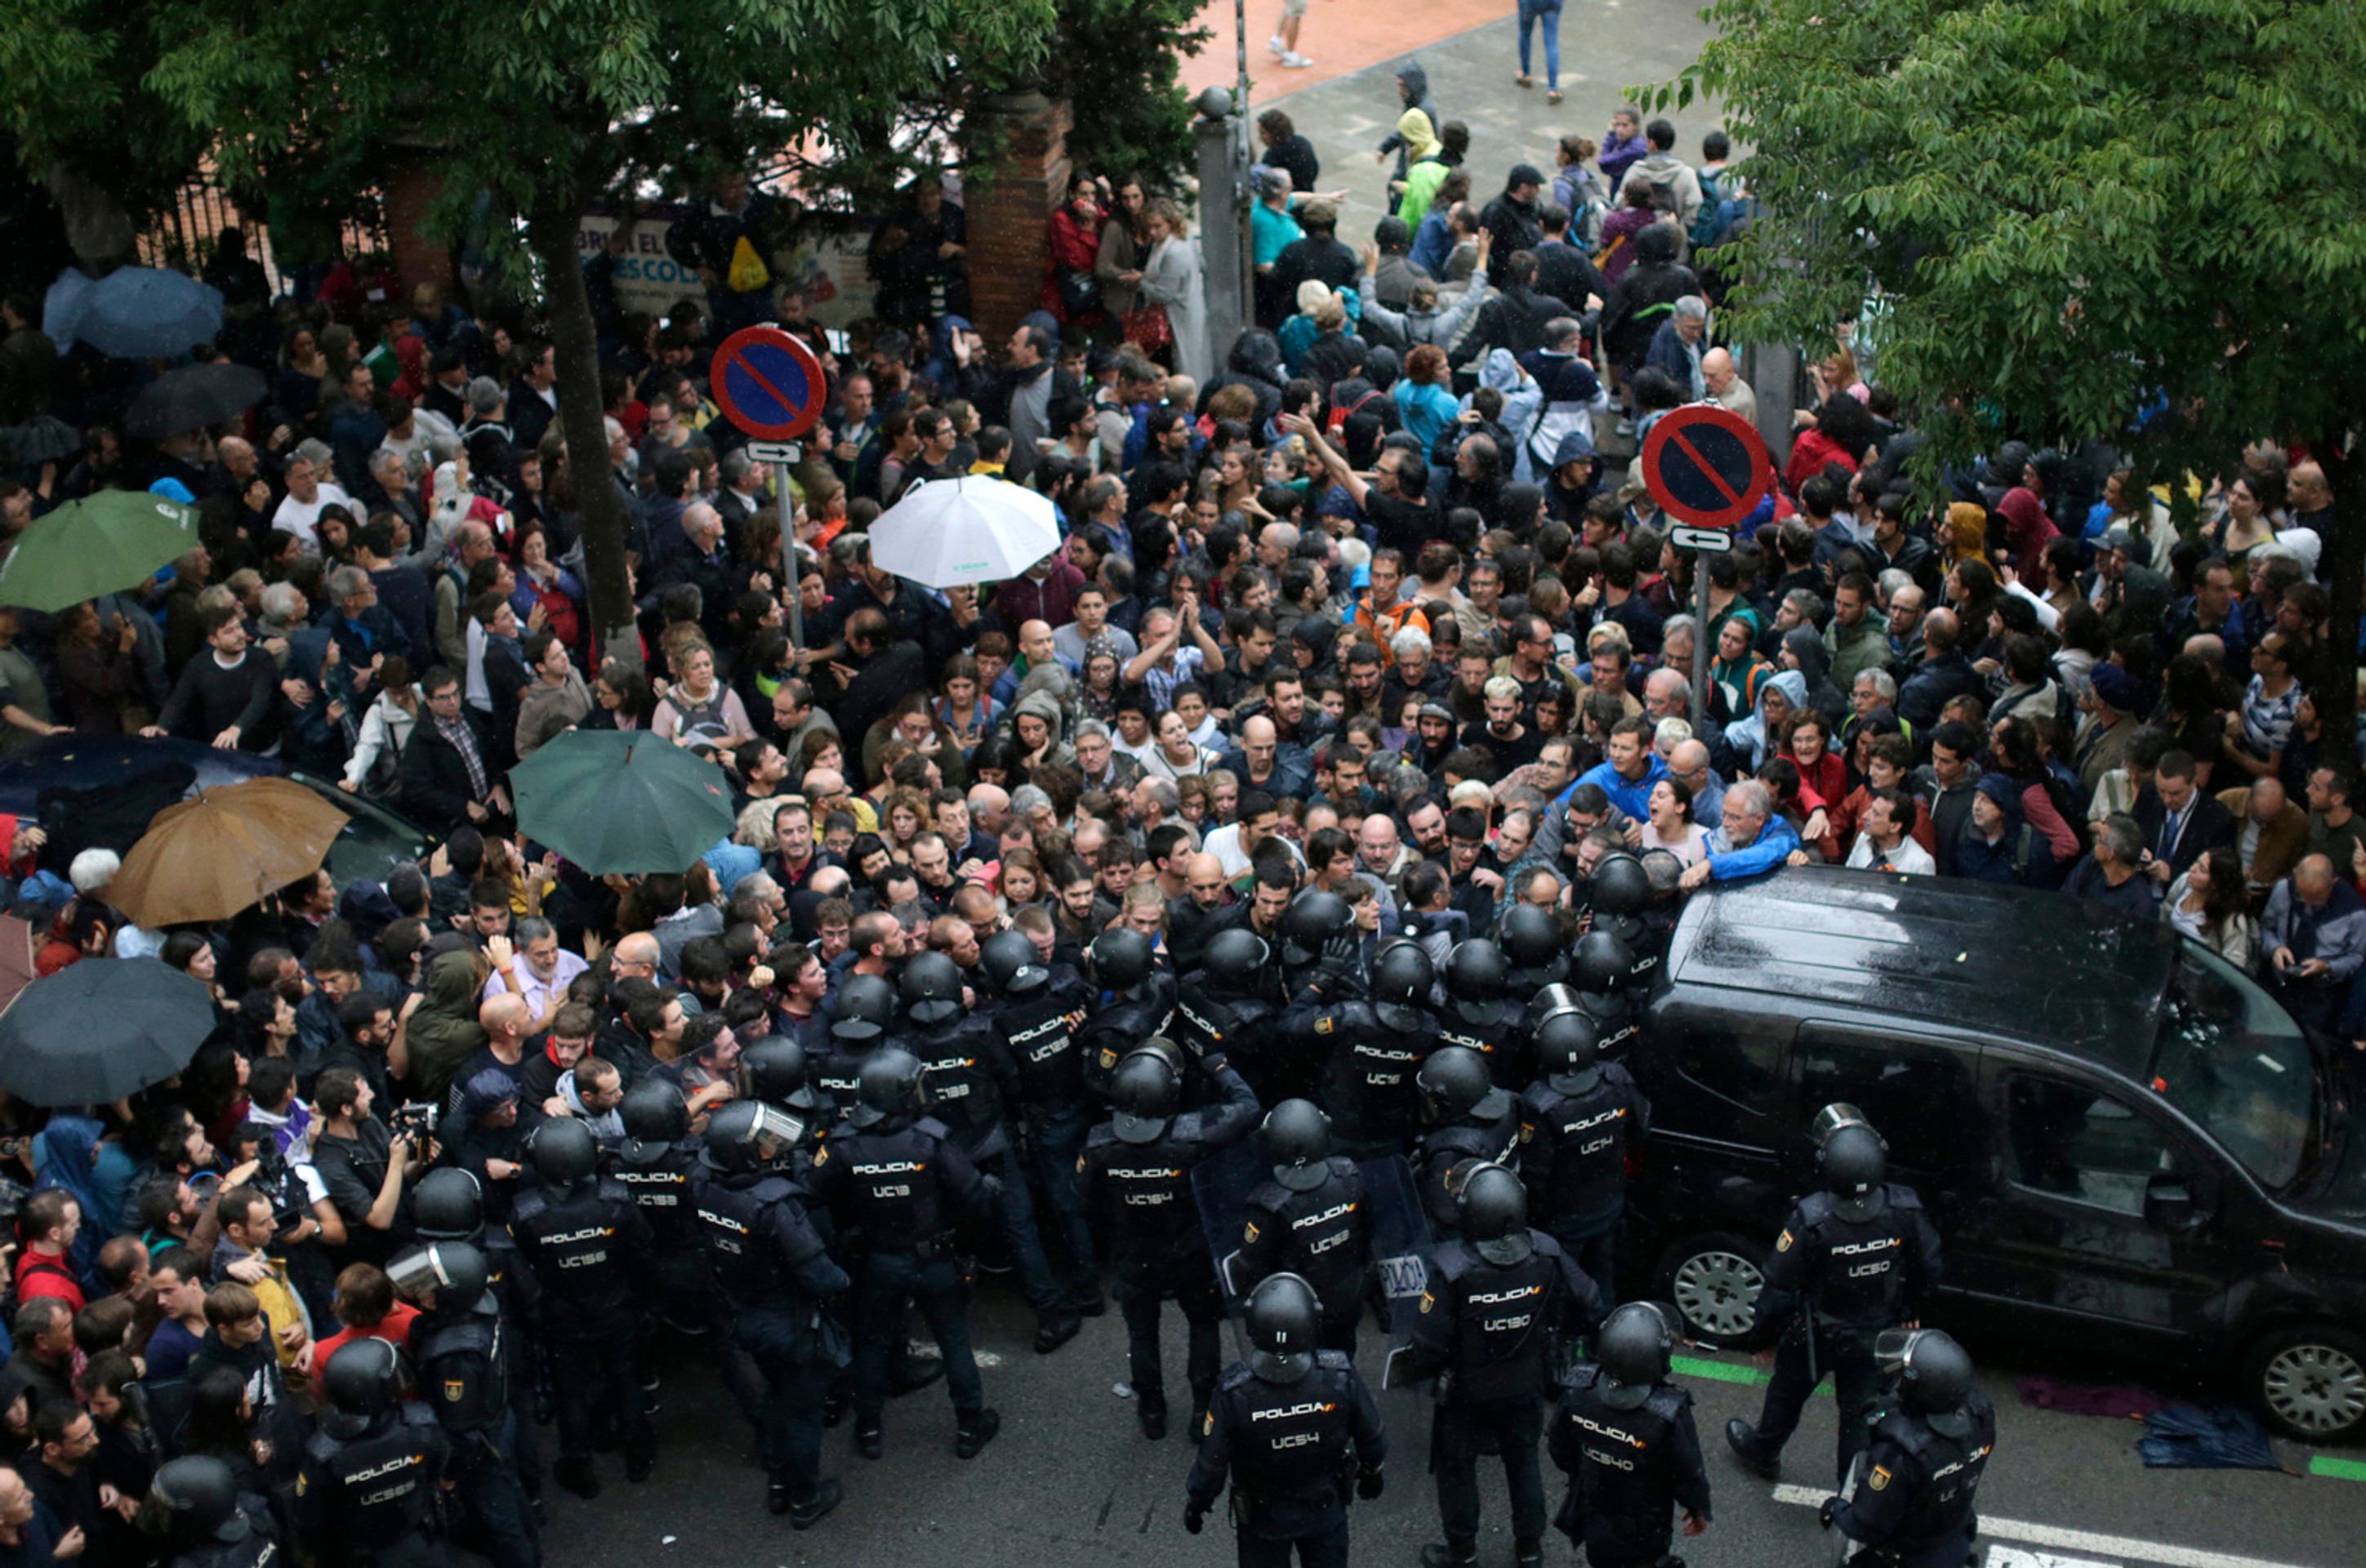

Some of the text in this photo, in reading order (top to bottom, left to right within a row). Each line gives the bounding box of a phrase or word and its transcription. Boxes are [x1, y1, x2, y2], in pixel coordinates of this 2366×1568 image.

[639, 233, 663, 255] EL
[1179, 1001, 1215, 1036] POLICIA
[1009, 1015, 1065, 1045] POLICIA
[1353, 1044, 1414, 1061] POLICIA
[1562, 1108, 1622, 1134] POLICIA
[614, 1172, 678, 1183] POLICIA
[852, 1161, 916, 1175] POLICIA
[1107, 1168, 1173, 1178] POLICIA
[697, 1209, 742, 1232] POLICIA
[1292, 1203, 1350, 1231] POLICIA
[540, 1226, 605, 1245] POLICIA
[1831, 1237, 1896, 1256] POLICIA
[1468, 1285, 1535, 1305] POLICIA
[1251, 1401, 1326, 1423] POLICIA
[1271, 1431, 1321, 1450] UC54
[1571, 1414, 1637, 1446] POLICIA
[345, 1454, 415, 1486] POLICIA
